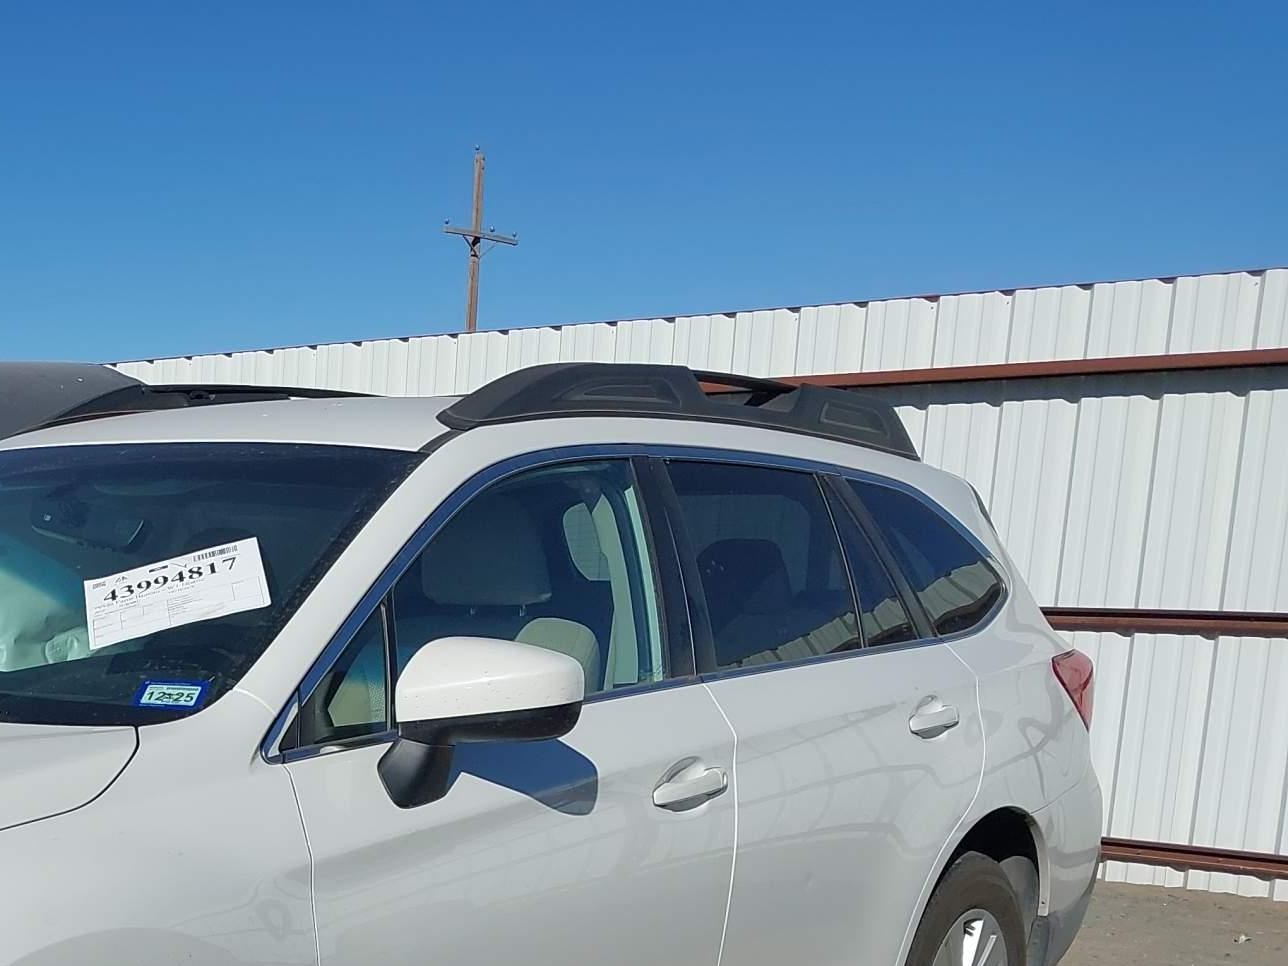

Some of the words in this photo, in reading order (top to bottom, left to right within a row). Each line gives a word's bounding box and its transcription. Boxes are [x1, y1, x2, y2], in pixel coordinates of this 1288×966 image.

[103, 556, 237, 602] 43994817
[146, 691, 165, 702] 12
[173, 691, 196, 703] 25
